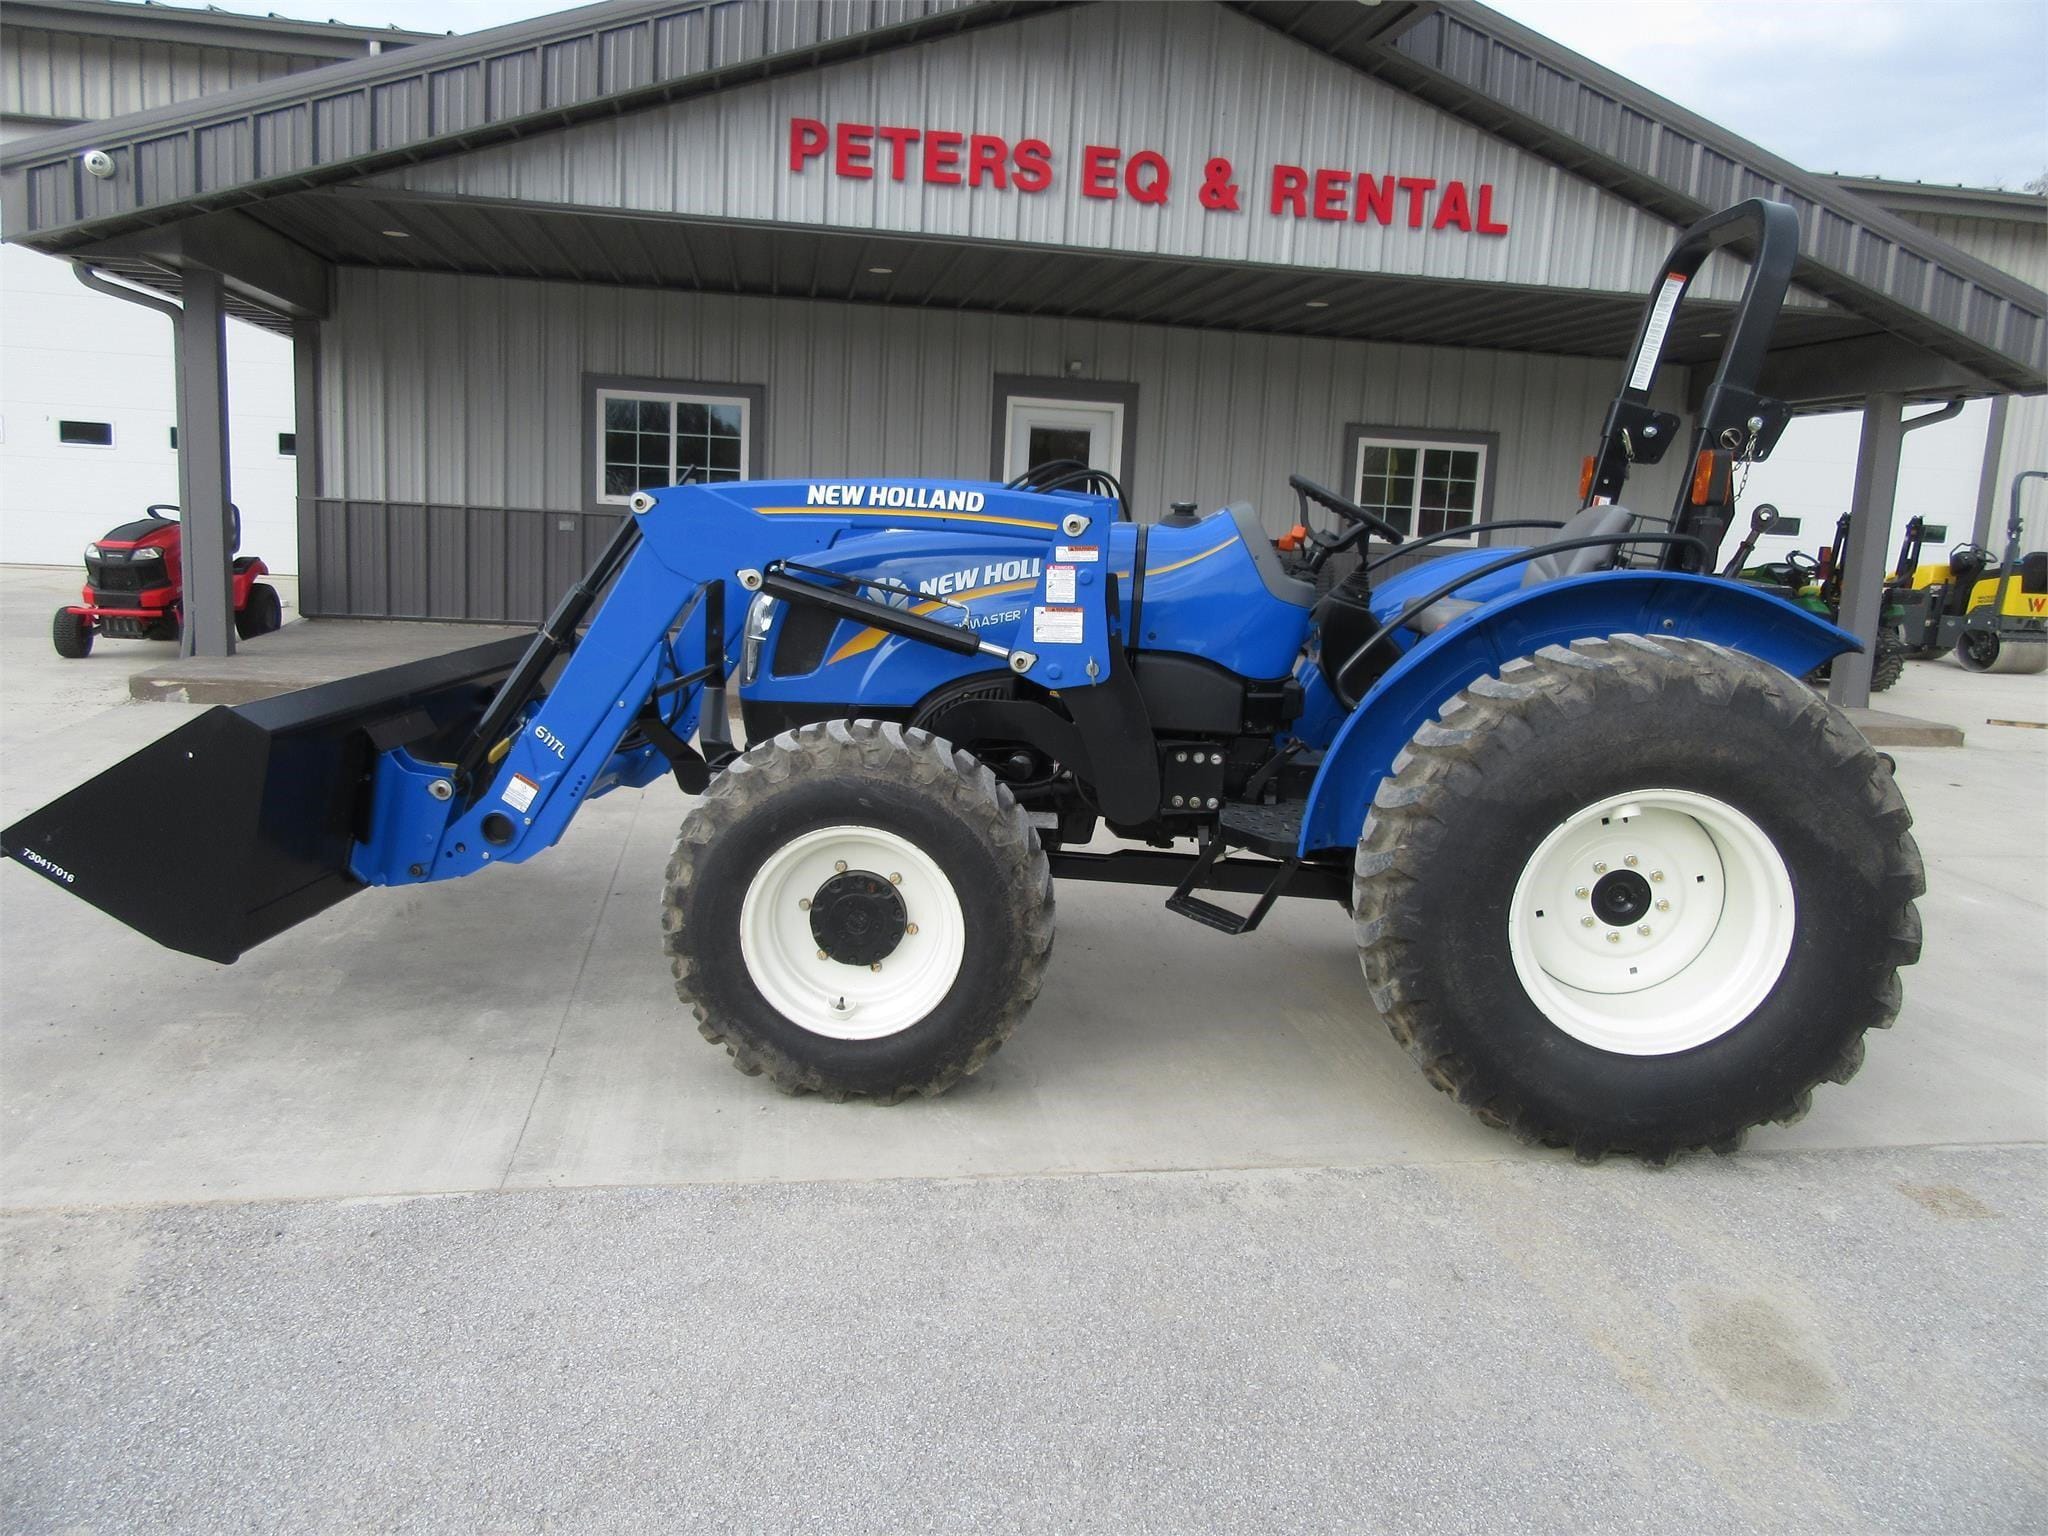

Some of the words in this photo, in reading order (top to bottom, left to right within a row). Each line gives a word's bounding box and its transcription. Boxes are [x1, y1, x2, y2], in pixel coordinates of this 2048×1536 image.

[790, 118, 1053, 193] PETERS
[1083, 145, 1170, 206] EQ
[1199, 157, 1240, 211] &
[1270, 164, 1508, 235] RENTAL
[807, 485, 865, 505] NEW
[868, 486, 985, 512] HOLLAND
[919, 567, 980, 601] NEW
[535, 725, 566, 760] 611TL
[23, 847, 75, 883] 730417016
